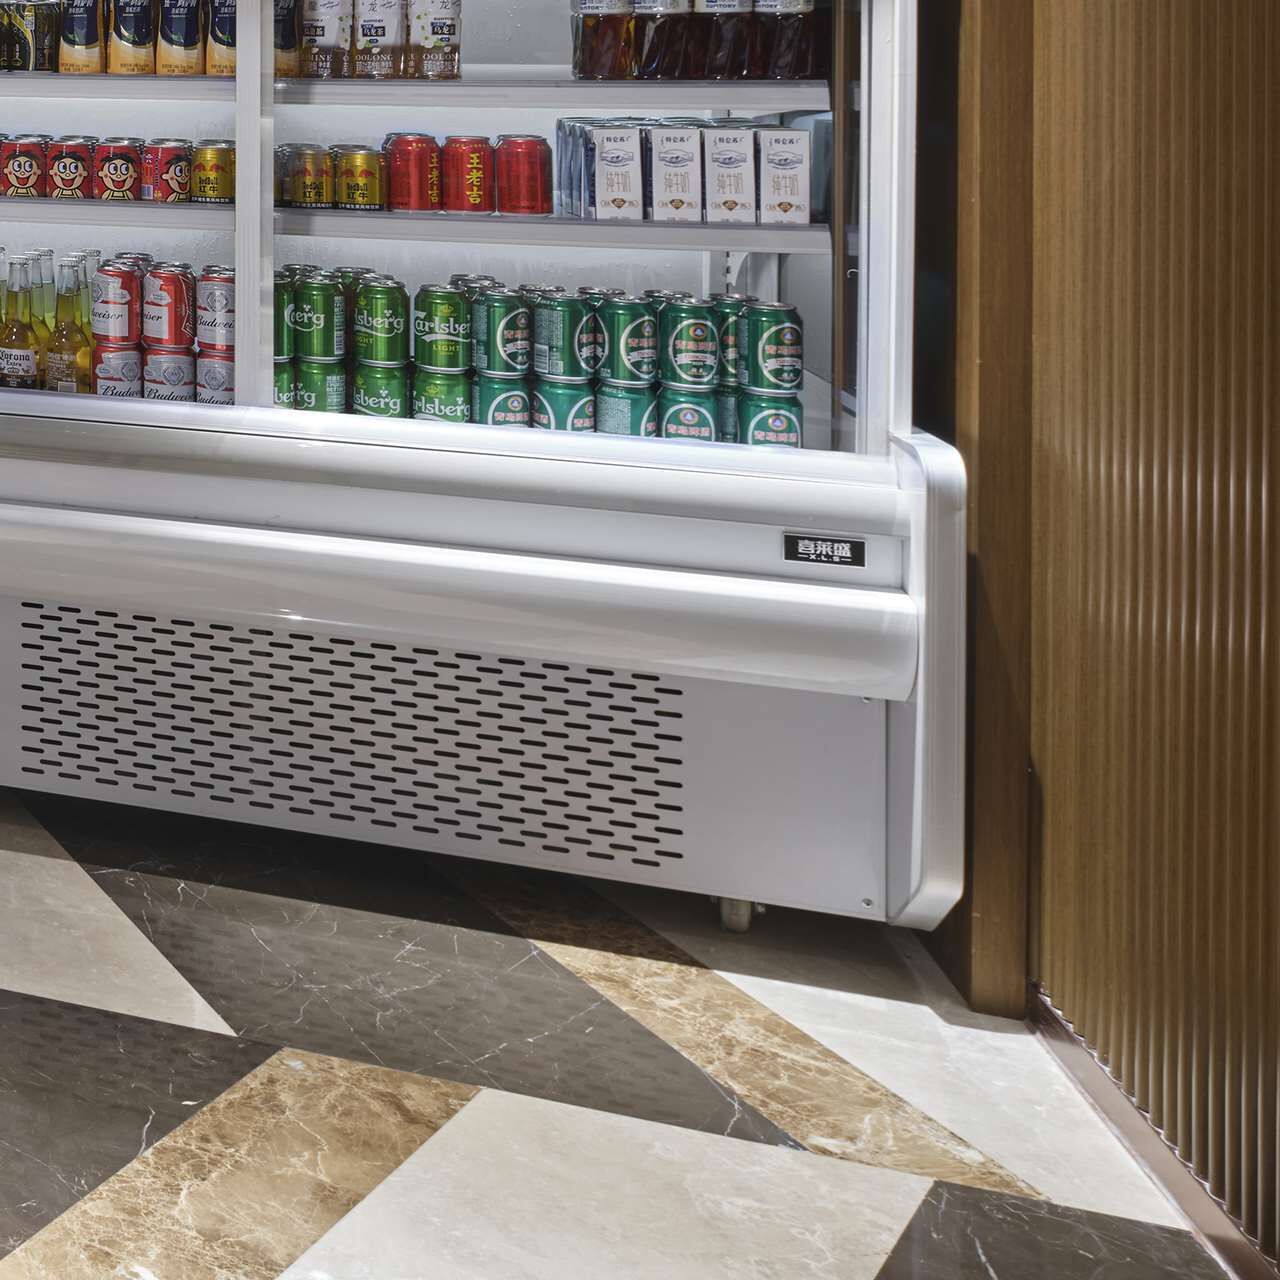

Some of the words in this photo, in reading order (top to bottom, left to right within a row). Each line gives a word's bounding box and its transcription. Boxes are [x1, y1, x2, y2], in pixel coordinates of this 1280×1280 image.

[466, 152, 484, 204] 王老吉
[414, 310, 471, 336] Carlsber
